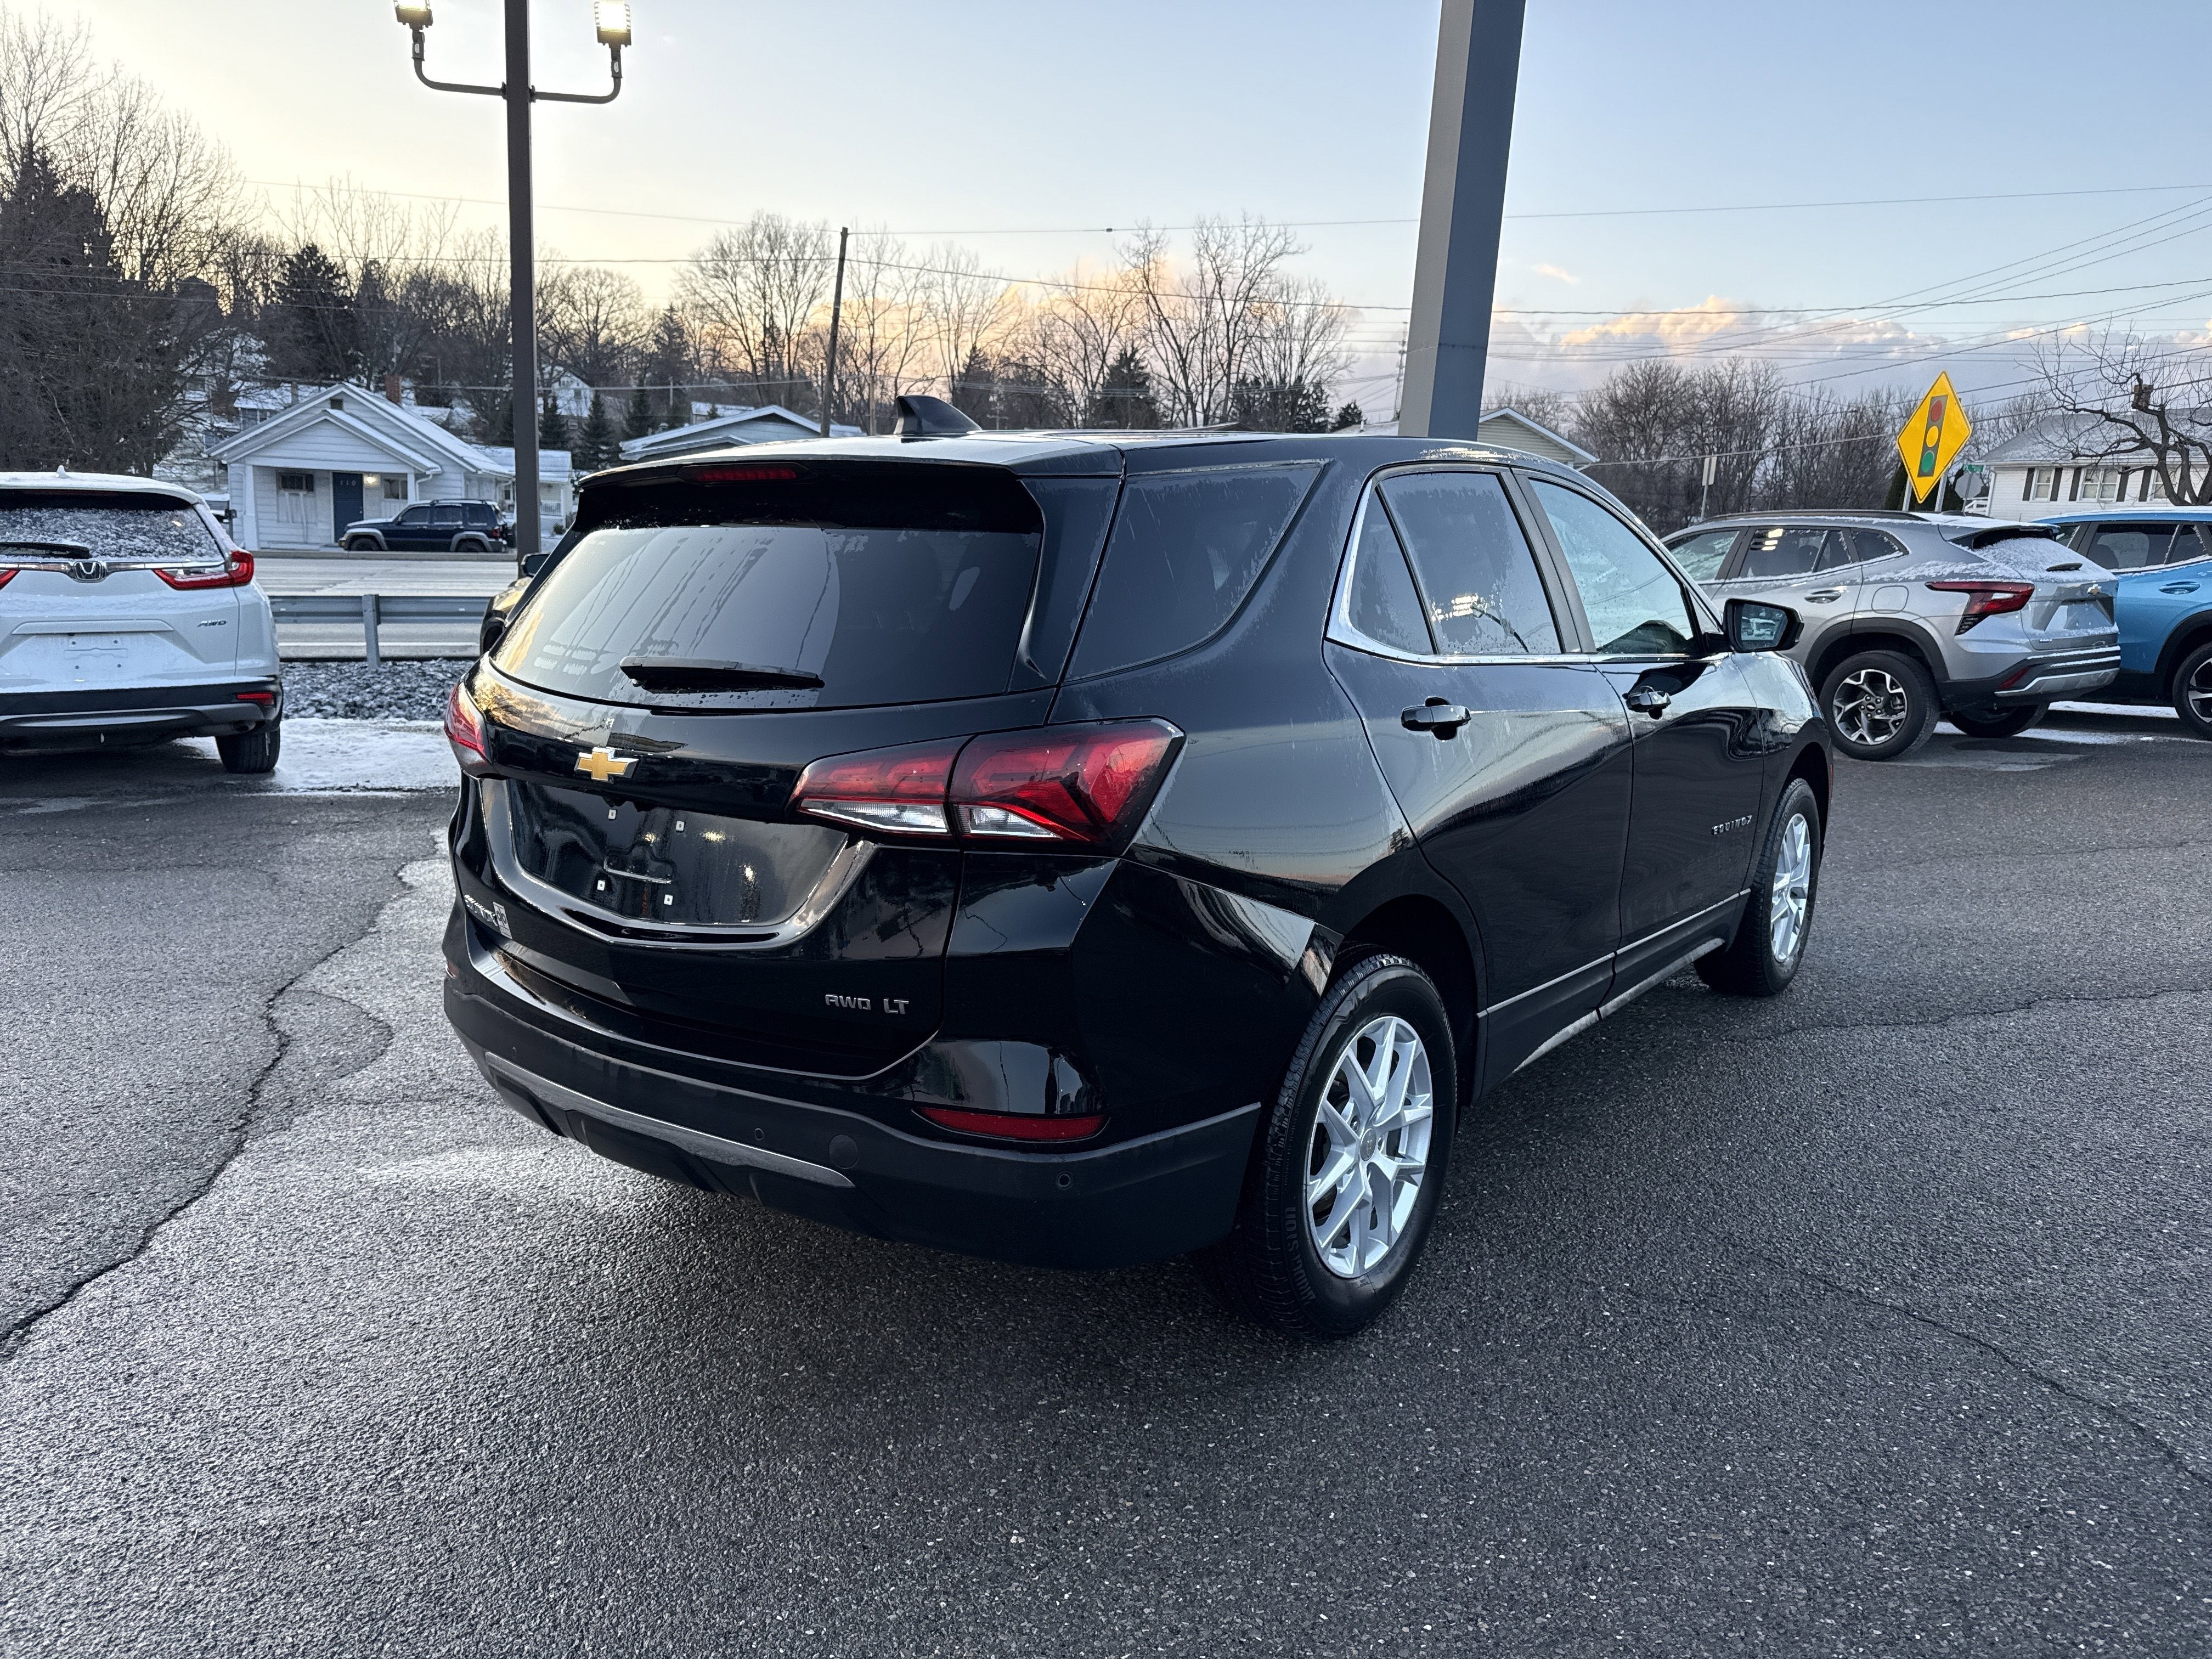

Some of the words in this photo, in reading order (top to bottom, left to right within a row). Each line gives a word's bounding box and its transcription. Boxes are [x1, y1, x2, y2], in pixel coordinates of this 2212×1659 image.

[1711, 815, 1752, 836] EQUINOX
[825, 994, 872, 1011] AWD
[883, 998, 910, 1014] LT
[1284, 1206, 1317, 1305] BRIDGSTON
